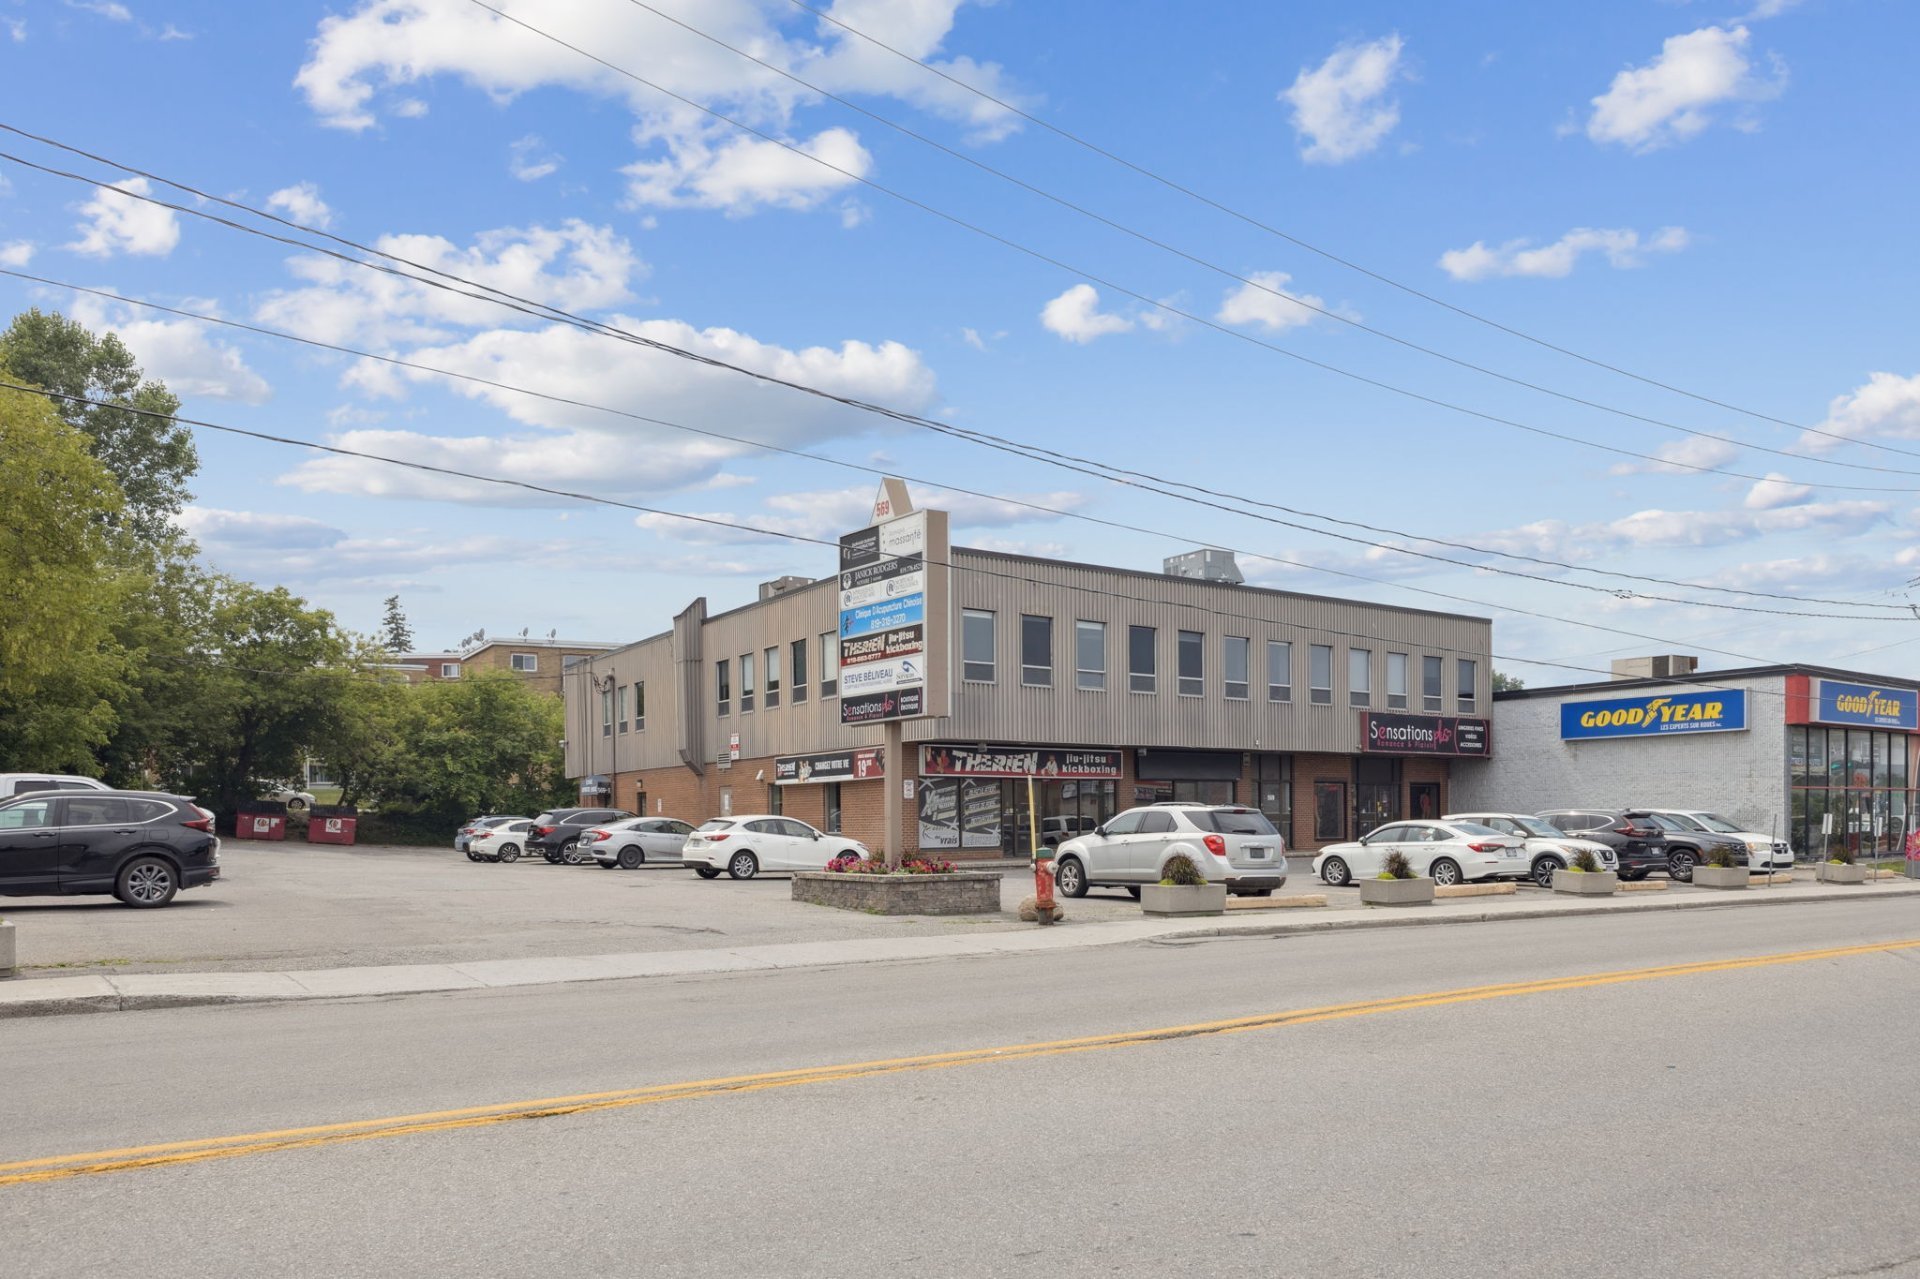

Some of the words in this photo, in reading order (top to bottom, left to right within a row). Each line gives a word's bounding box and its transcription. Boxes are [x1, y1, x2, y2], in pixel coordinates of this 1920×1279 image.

[876, 500, 890, 517] 569
[873, 561, 898, 576] RODGERS
[886, 641, 923, 654] kickboxing
[844, 672, 863, 684] STEVE
[863, 668, 893, 682] BÉLIVEAU
[843, 701, 882, 717] Sensations
[1370, 720, 1433, 741] Sensations
[1669, 722, 1689, 730] EXPERTS
[1700, 720, 1715, 728] ROUES
[814, 761, 831, 771] CHANGEZ
[831, 760, 843, 769] VOTRE
[952, 750, 1038, 775] THERIEN
[1066, 753, 1106, 764] jiu-jitsu
[1062, 764, 1117, 776] kickboxing
